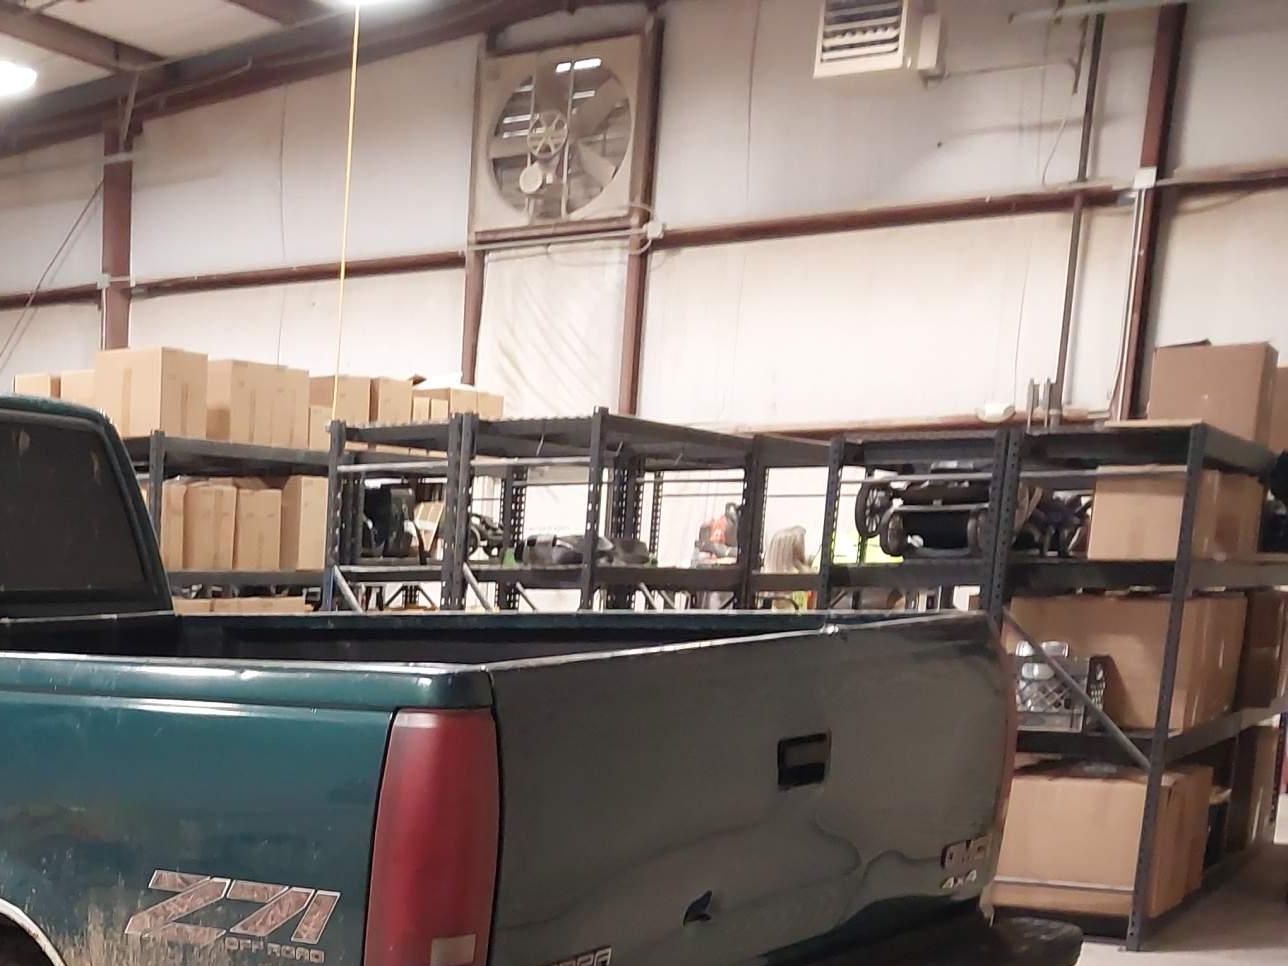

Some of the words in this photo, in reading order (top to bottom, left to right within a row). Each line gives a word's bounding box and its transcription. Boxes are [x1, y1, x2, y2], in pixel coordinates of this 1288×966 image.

[124, 869, 341, 945] Z71
[225, 936, 264, 953] OFF
[267, 942, 325, 964] ROAD
